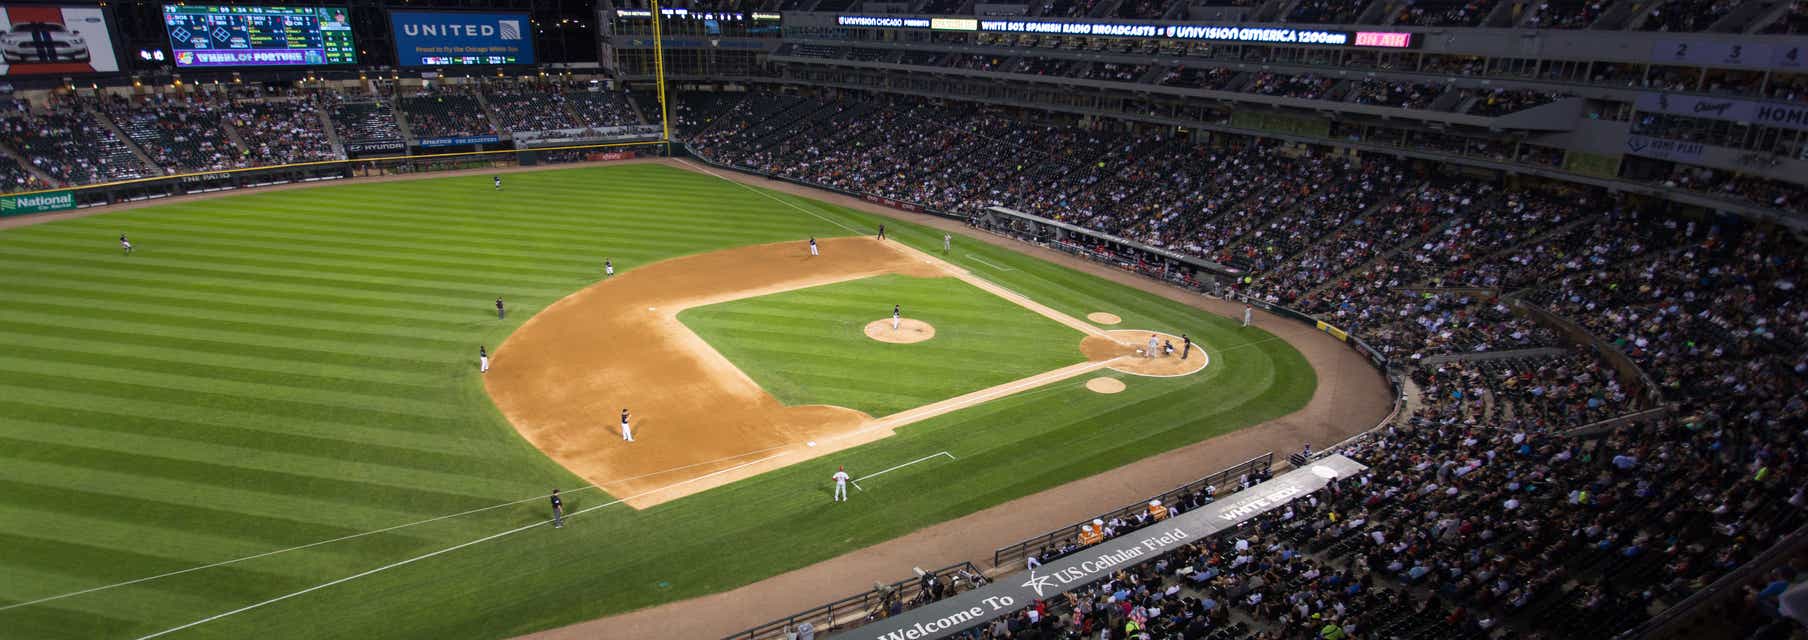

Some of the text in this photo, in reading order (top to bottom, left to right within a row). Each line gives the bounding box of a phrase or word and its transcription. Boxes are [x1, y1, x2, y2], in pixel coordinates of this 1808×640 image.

[844, 17, 876, 26] UNIVISION
[876, 18, 902, 27] CHICAGO
[982, 21, 1006, 31] WHITE
[1008, 22, 1025, 31] SOX
[1026, 22, 1061, 33] SPANISH
[1063, 24, 1091, 34] RADIO
[1092, 24, 1155, 36] BROADCASTS
[403, 24, 494, 37] UNITED
[1676, 43, 1799, 61] 2 3 4
[203, 172, 231, 181] PATIO
[17, 193, 72, 208] National
[1218, 498, 1270, 521] WHITE
[1141, 527, 1190, 551] Field
[983, 594, 1015, 611] To
